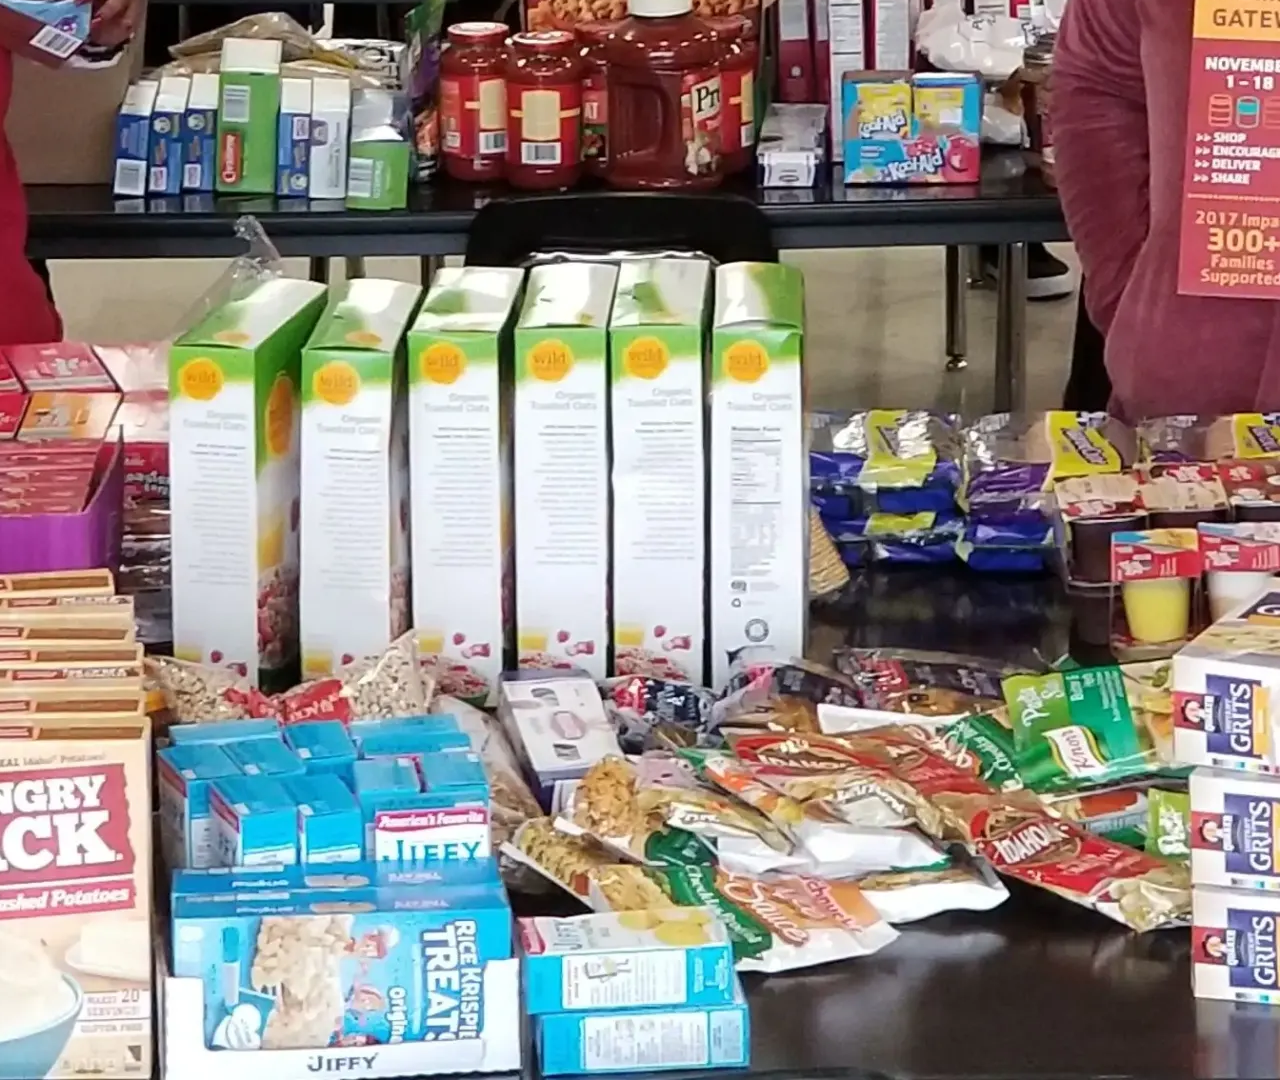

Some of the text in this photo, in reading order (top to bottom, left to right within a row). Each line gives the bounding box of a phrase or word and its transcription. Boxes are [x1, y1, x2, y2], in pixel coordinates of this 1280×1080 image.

[1226, 75, 1274, 91] 1 18
[1212, 132, 1247, 144] SHOP
[888, 150, 944, 180] Kool-Aid
[1211, 159, 1261, 171] DELIVER
[1211, 173, 1250, 185] SHARE
[1195, 210, 1238, 227] 2017
[1210, 254, 1275, 271] Families
[426, 351, 460, 370] wild
[533, 350, 566, 367] wild
[629, 347, 663, 364] wild
[185, 369, 217, 386] wild
[321, 373, 354, 389] wild
[1230, 682, 1253, 754] GRITS
[378, 809, 487, 829] America's Favorite
[1251, 800, 1273, 872] GRITS
[51, 887, 130, 911] Potatoes
[723, 880, 809, 947] Sauce
[1253, 914, 1275, 986] GRITS
[454, 920, 482, 1040] RICE KRISPIE
[307, 1053, 379, 1073] JIFFY
